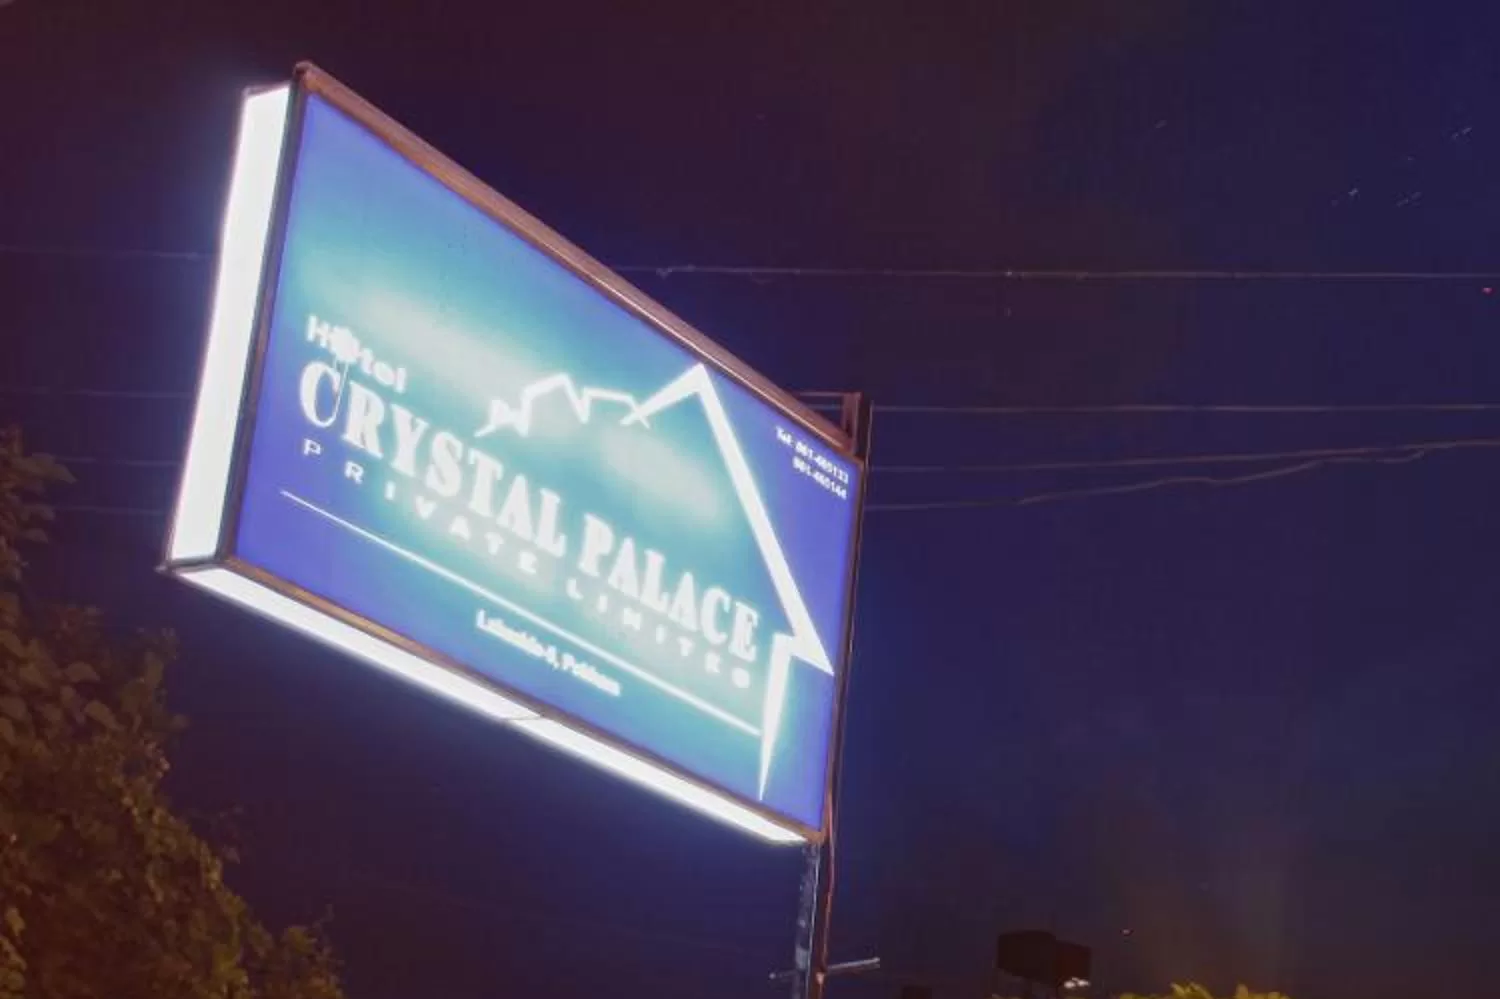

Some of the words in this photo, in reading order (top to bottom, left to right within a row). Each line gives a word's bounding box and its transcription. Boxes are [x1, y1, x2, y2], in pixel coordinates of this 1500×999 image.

[299, 360, 566, 558] CRYSTAL
[578, 512, 758, 662] PALACE
[303, 438, 538, 574] PRIVATE
